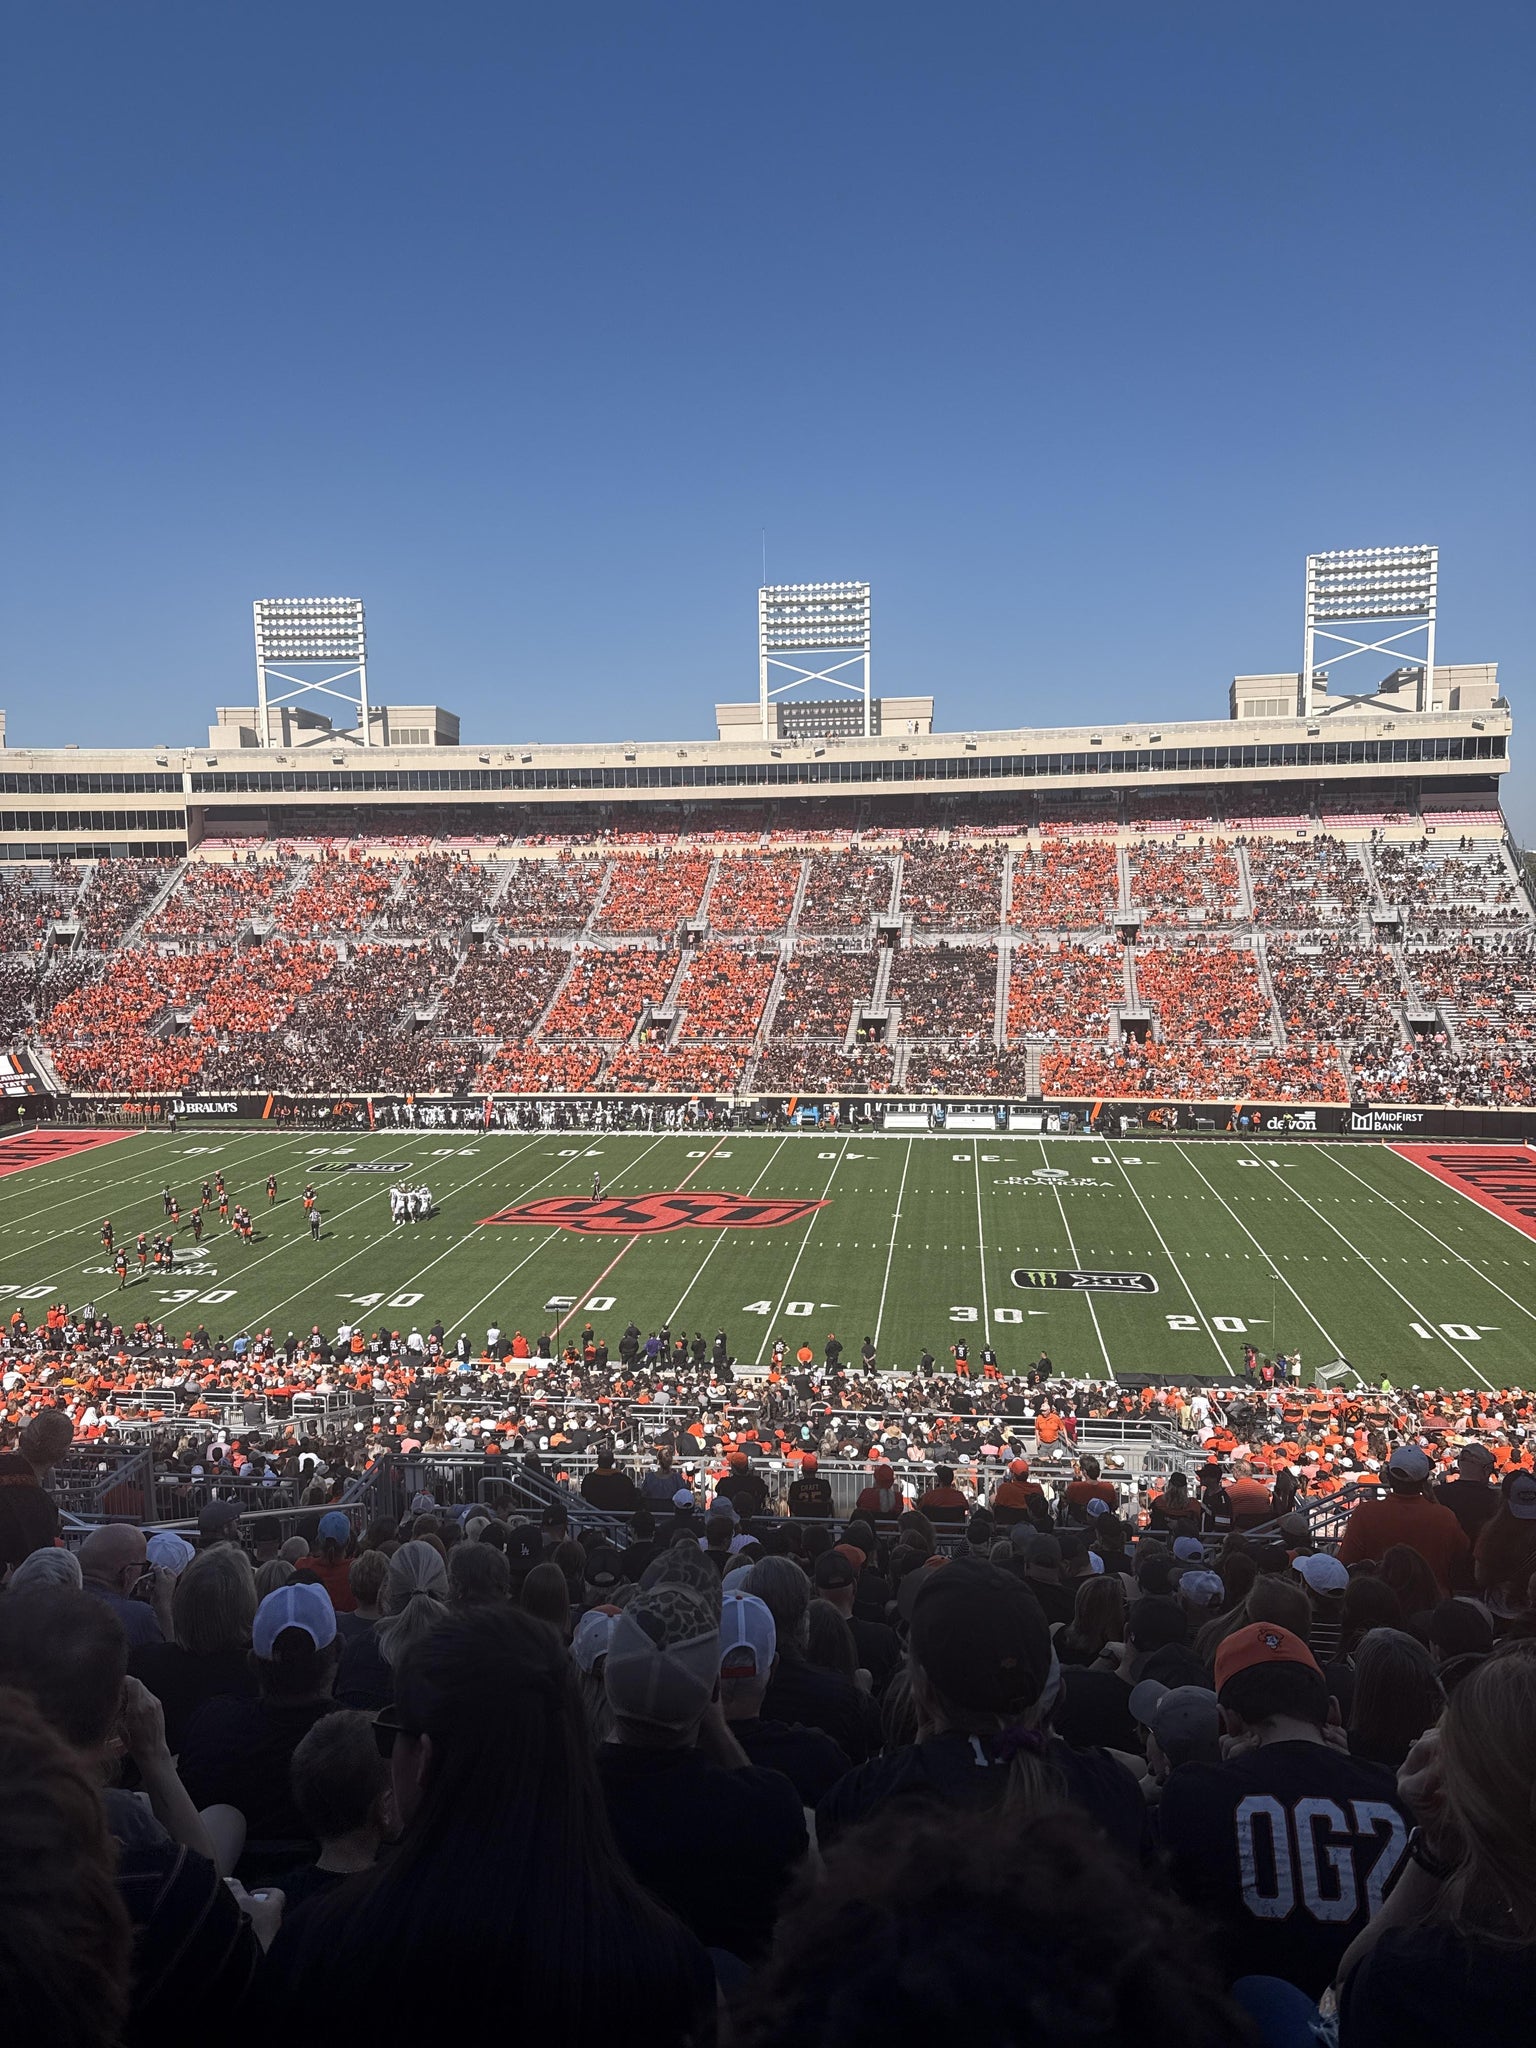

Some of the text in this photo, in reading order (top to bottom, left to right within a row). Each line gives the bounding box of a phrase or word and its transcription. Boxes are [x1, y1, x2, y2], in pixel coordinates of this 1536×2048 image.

[0, 1073, 37, 1081] AHOMA
[186, 1102, 238, 1113] BRAUM'S
[1267, 1116, 1317, 1131] devon
[1374, 1122, 1404, 1132] BANK
[159, 1289, 238, 1303] 30
[350, 1293, 425, 1307] 40
[742, 1300, 814, 1316] 40
[949, 1306, 1023, 1323] 30
[1166, 1314, 1249, 1333] 20
[1409, 1322, 1483, 1340] 10
